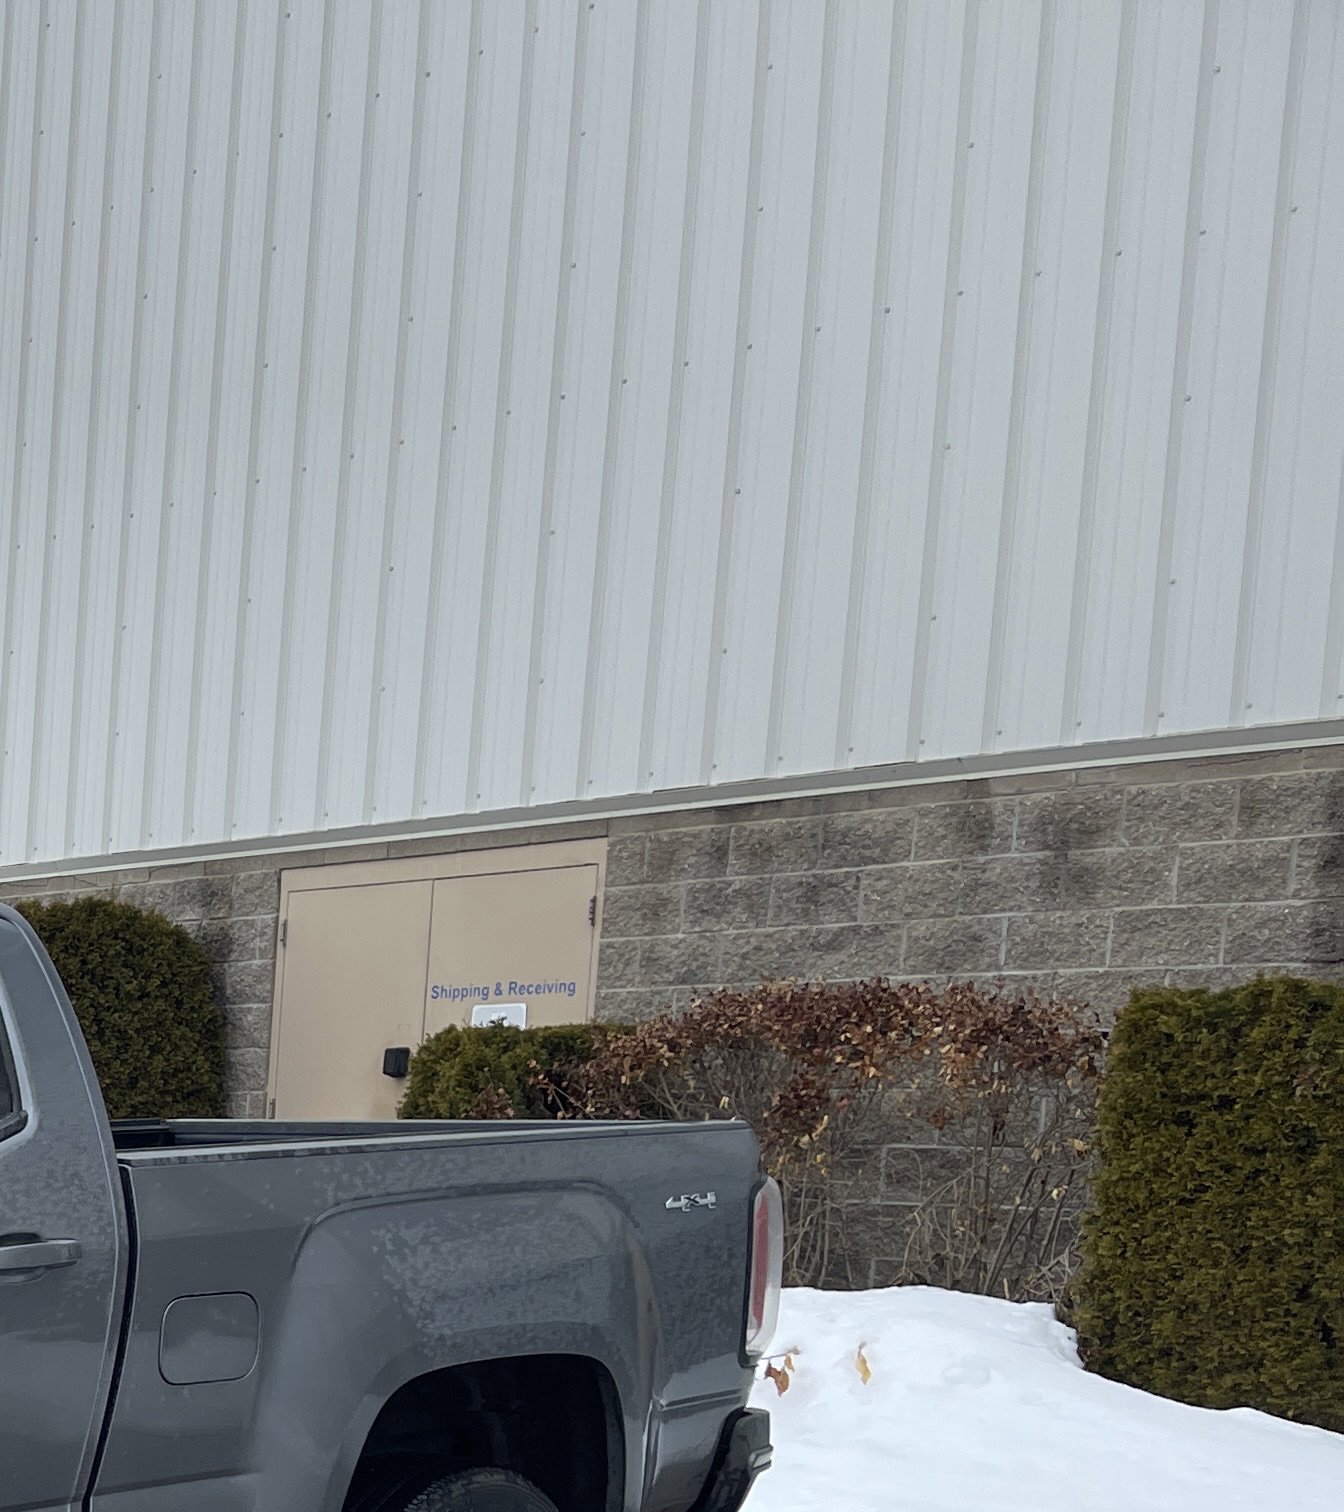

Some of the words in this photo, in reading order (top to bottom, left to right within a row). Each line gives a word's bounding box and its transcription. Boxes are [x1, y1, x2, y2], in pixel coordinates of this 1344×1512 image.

[431, 984, 490, 1001] Shipping
[494, 981, 503, 996] &
[508, 978, 576, 997] Receiving
